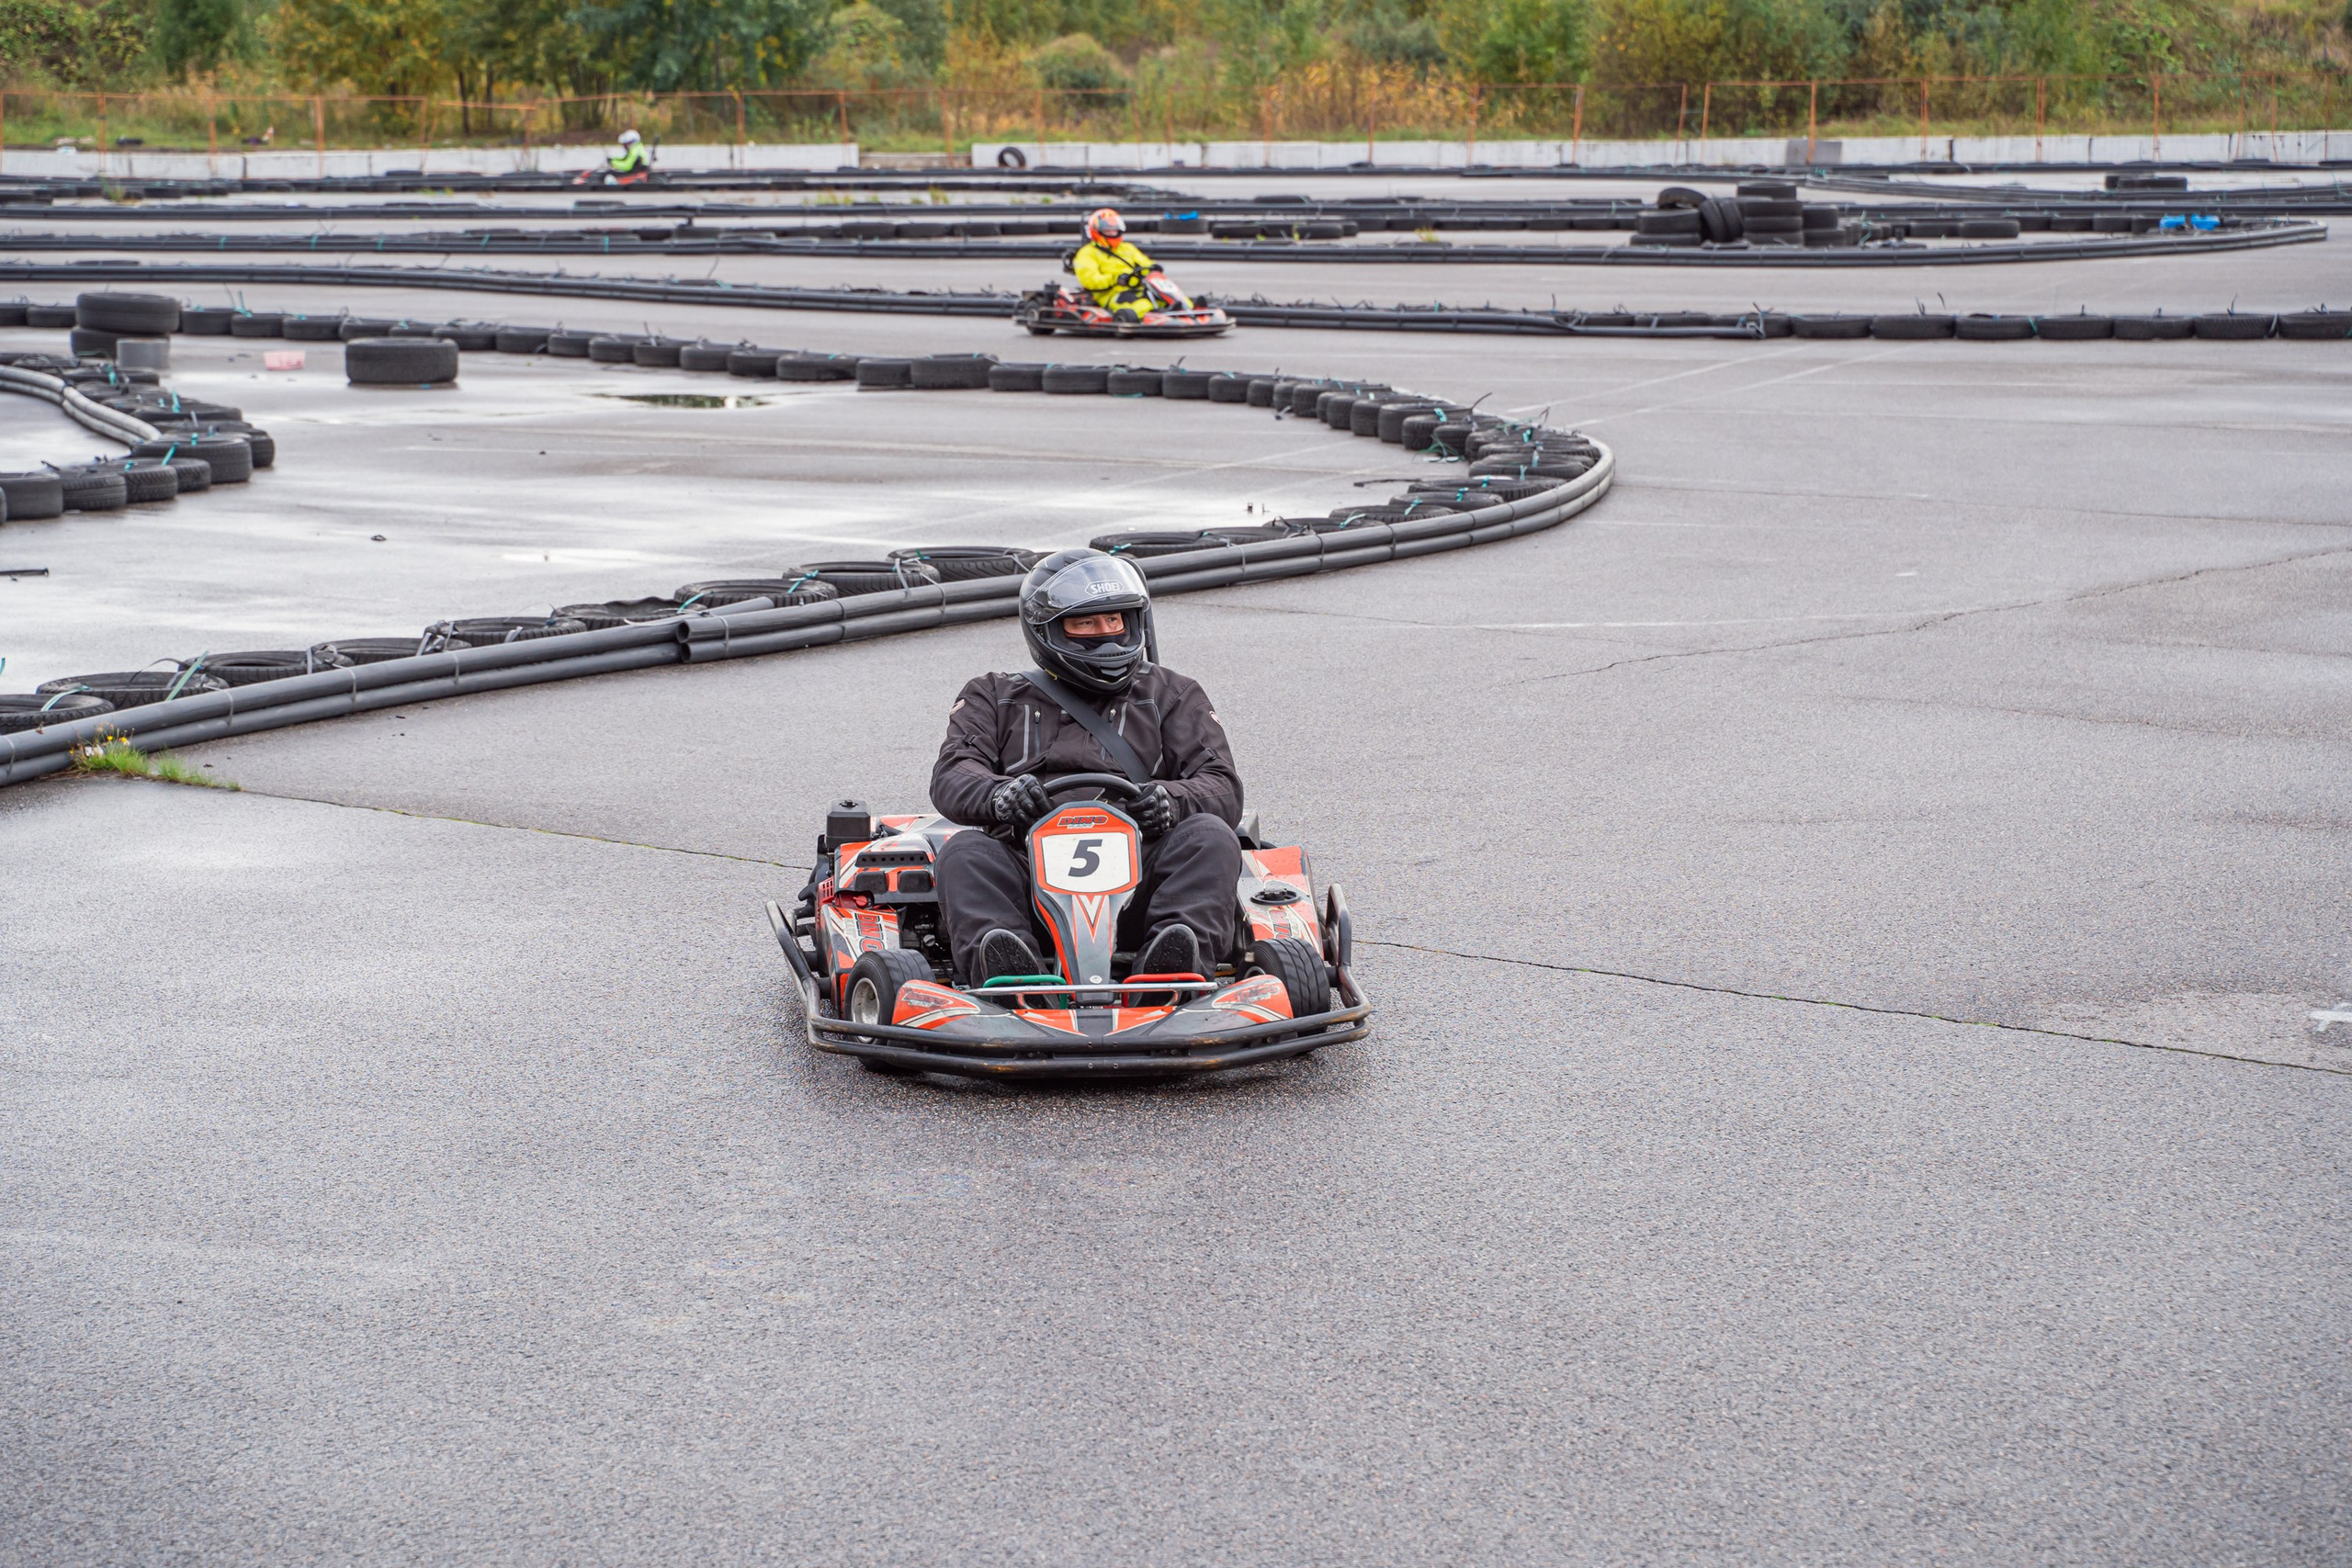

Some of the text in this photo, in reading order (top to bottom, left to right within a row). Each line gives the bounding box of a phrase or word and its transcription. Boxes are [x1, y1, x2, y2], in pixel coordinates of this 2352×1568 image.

[1091, 582, 1119, 594] SHOEI
[1058, 816, 1107, 825] DINO
[1068, 839, 1102, 877] 5
[854, 912, 885, 953] DINO
